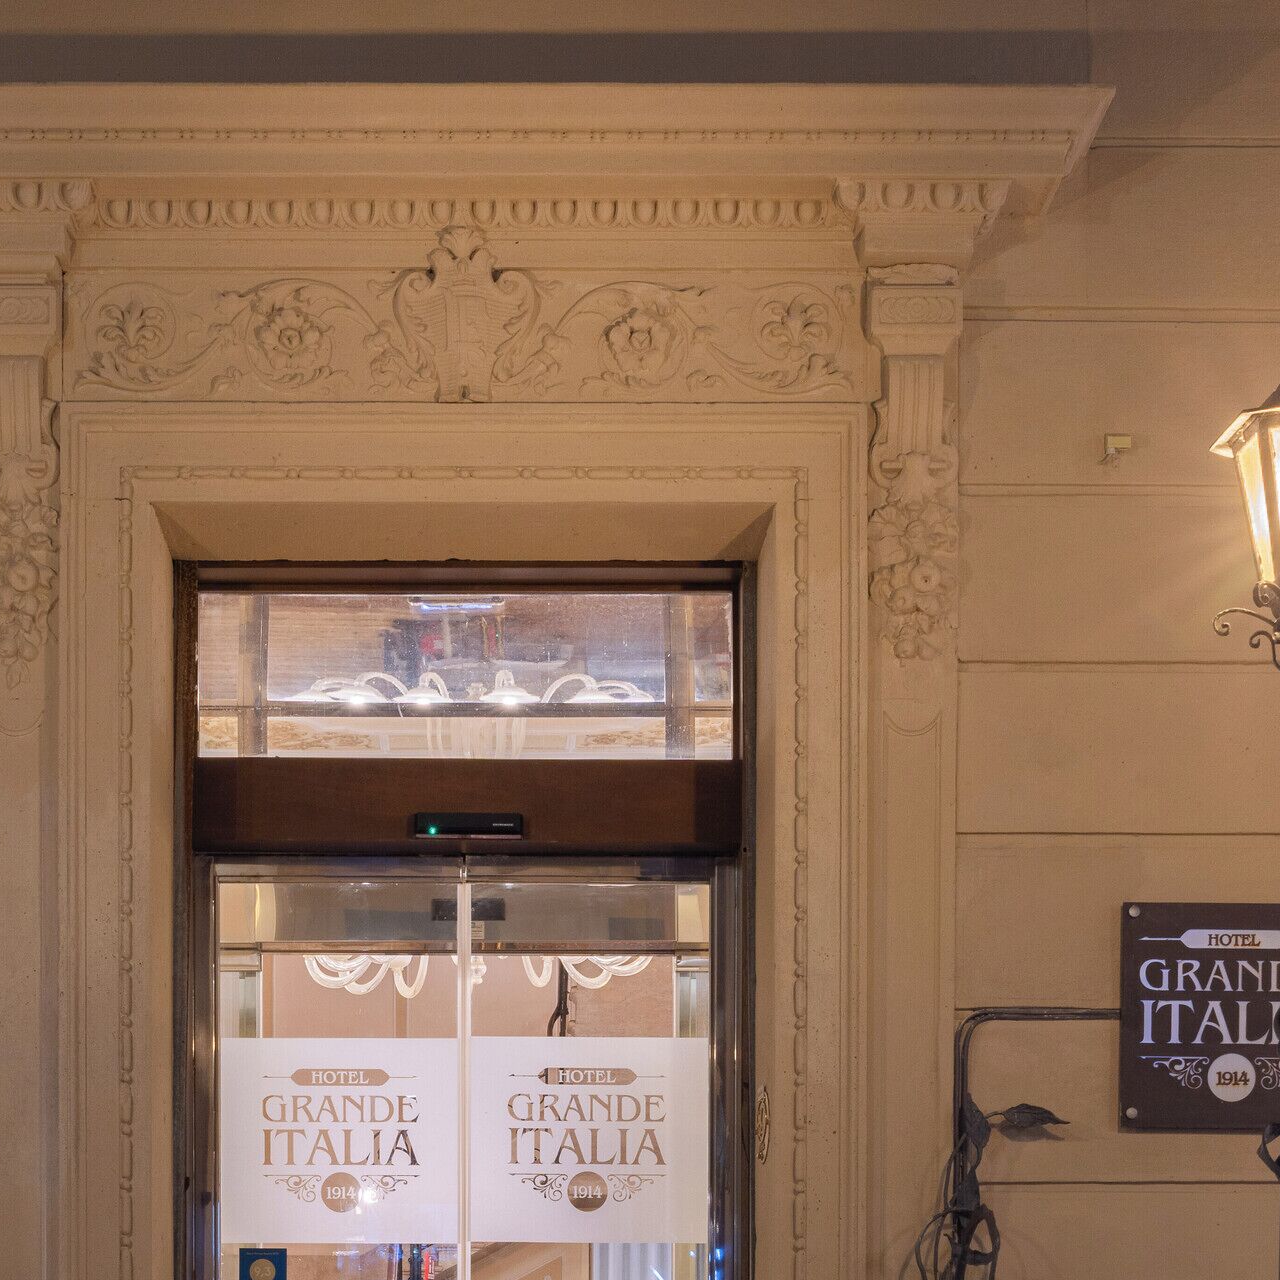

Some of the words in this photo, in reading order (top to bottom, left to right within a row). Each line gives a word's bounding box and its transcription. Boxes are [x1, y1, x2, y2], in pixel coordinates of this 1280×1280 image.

[1208, 934, 1261, 947] HOTEL
[311, 1071, 370, 1084] HOTEL
[558, 1069, 617, 1084] HOTEL
[1215, 1071, 1250, 1086] 1914
[261, 1094, 421, 1123] GRANDE
[507, 1093, 667, 1122] GRANDE
[261, 1128, 421, 1166] ITALIA
[507, 1127, 667, 1165] ITALIA
[326, 1186, 357, 1200] 1914
[571, 1184, 603, 1199] 1914
